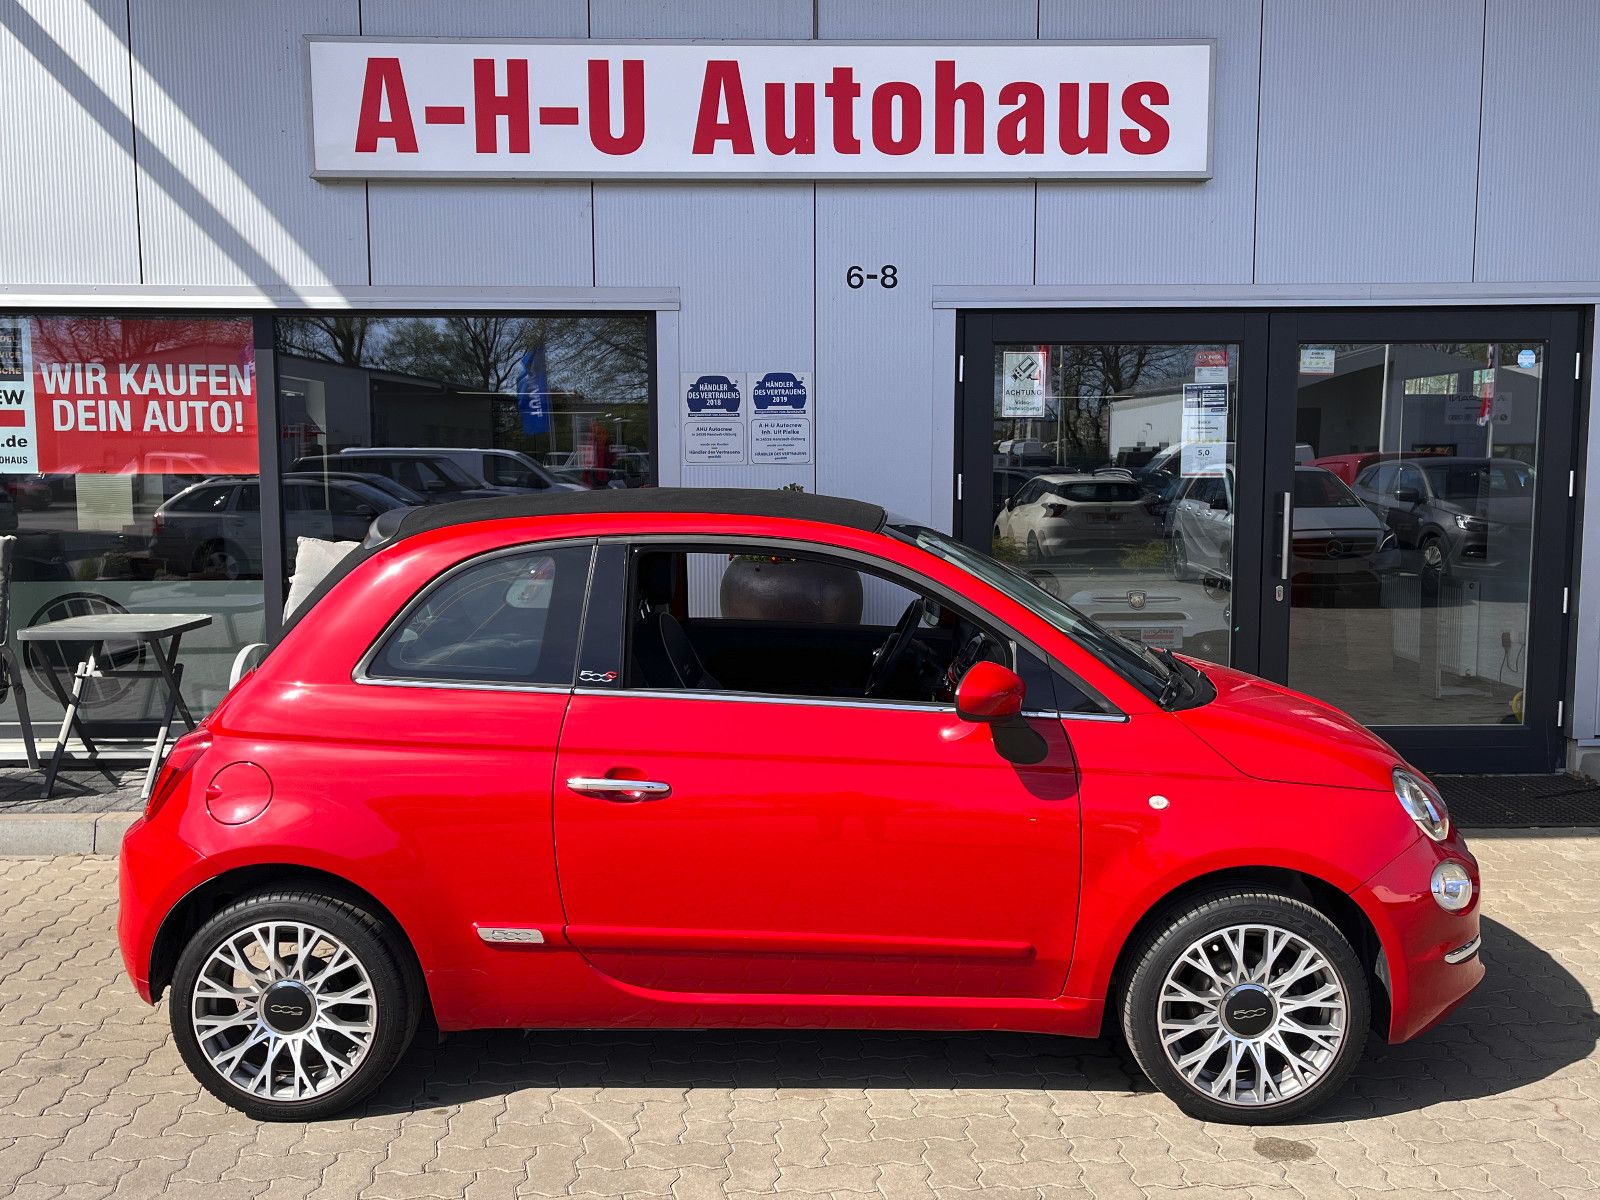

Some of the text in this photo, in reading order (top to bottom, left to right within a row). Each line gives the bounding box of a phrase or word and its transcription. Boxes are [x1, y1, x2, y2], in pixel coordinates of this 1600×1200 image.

[355, 57, 1171, 156] A-H-U Autohaus
[846, 264, 898, 289] 6-8
[41, 363, 251, 396] WIR KAUFEN
[699, 383, 728, 391] HÄNDLER
[766, 388, 806, 396] VERTRAUENS
[688, 391, 739, 399] DES VERTRAUENS
[52, 399, 244, 433] DEIN AUTO!
[1197, 449, 1210, 457] 5,0
[491, 929, 532, 941] 500
[1233, 1008, 1267, 1020] 500
